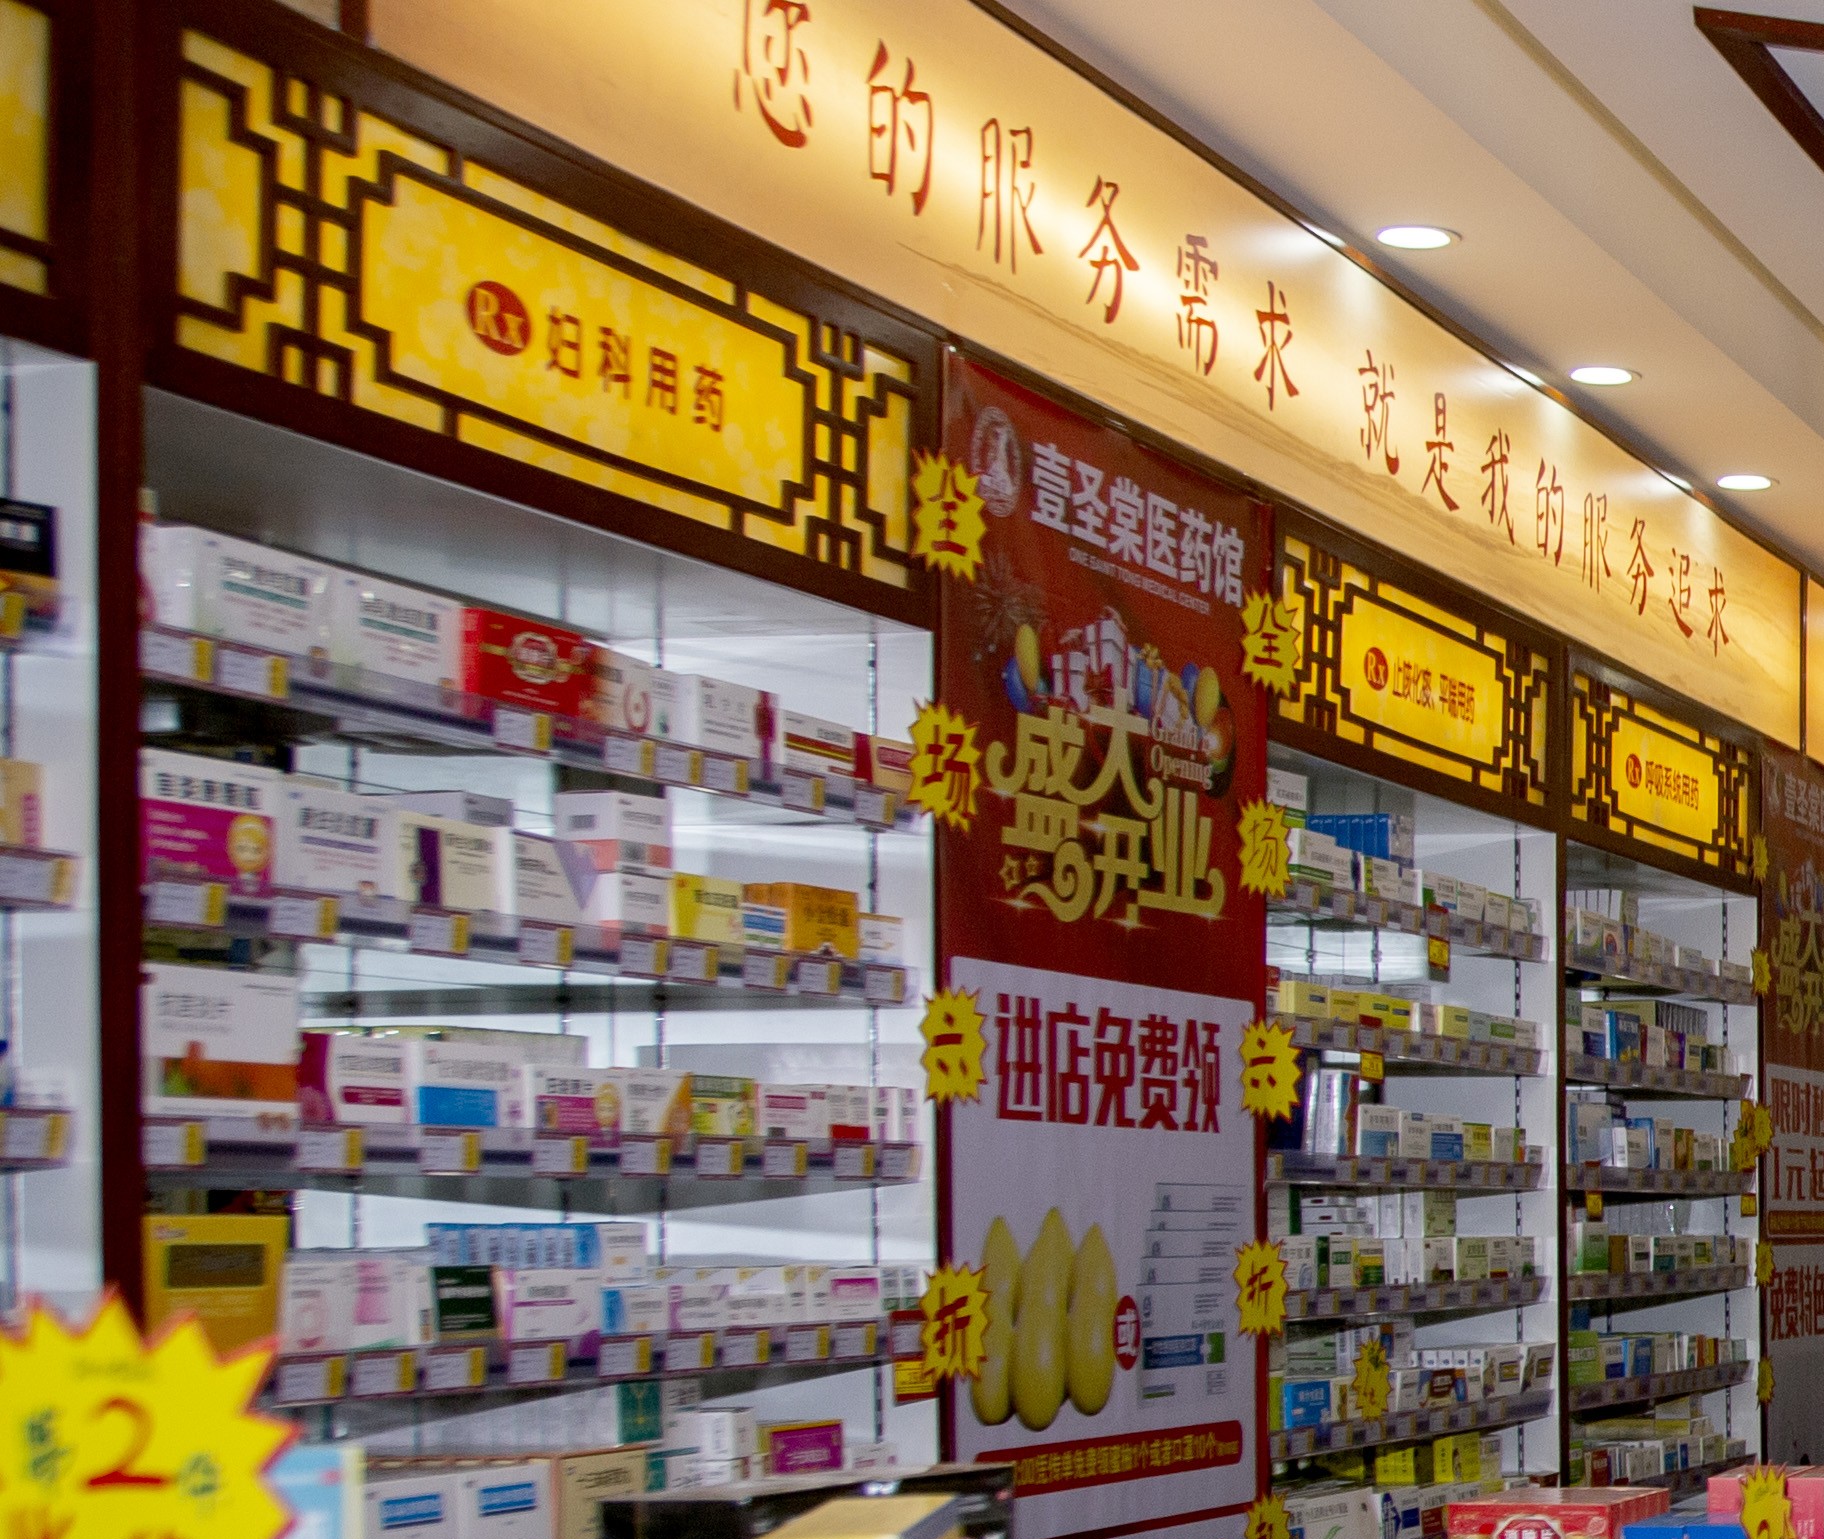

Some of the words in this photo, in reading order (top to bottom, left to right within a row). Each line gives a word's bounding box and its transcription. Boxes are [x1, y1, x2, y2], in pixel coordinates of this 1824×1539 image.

[545, 304, 726, 433] 妇科用药
[733, 0, 1299, 411] 您的服务需求
[1358, 349, 1731, 657] 就是我的服务追求
[1030, 440, 1245, 609] 壹圣棠医药馆
[921, 722, 976, 819] 场
[985, 692, 1229, 925] 盛大开业
[1645, 758, 1700, 812] 呼吸系统用药
[1247, 816, 1280, 881] 场
[993, 993, 1221, 1134] 进店免费领
